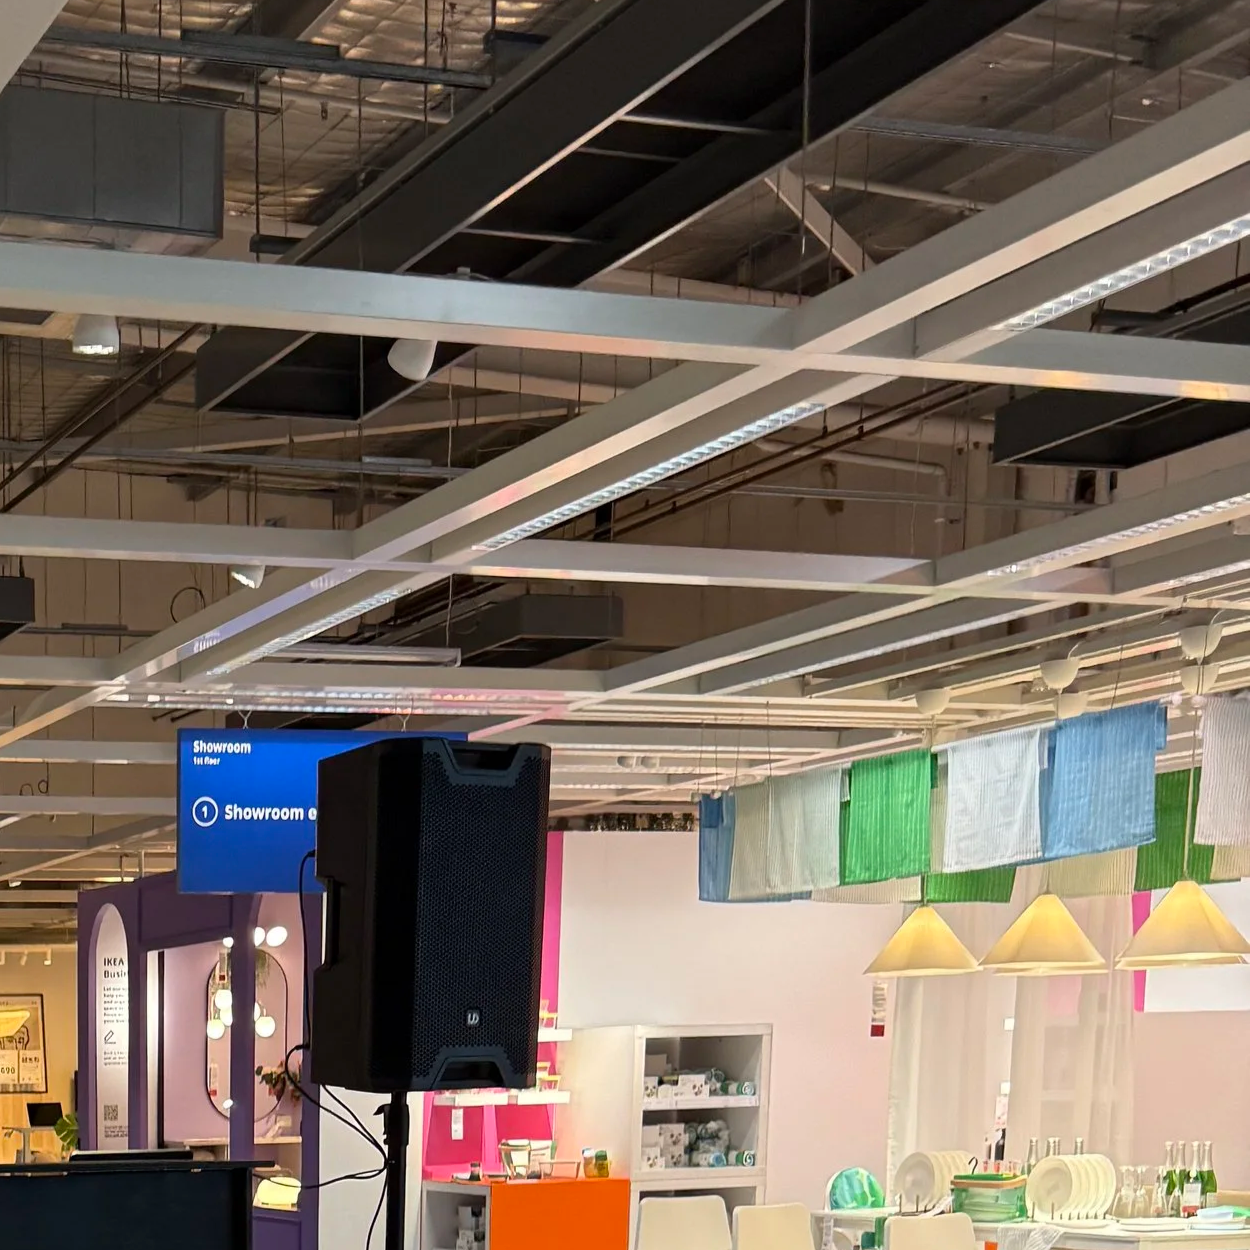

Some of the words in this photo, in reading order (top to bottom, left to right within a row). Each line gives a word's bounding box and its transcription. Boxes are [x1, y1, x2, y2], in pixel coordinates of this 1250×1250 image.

[193, 739, 252, 754] Showroom
[224, 803, 305, 821] Showroom
[103, 957, 125, 967] IKEA
